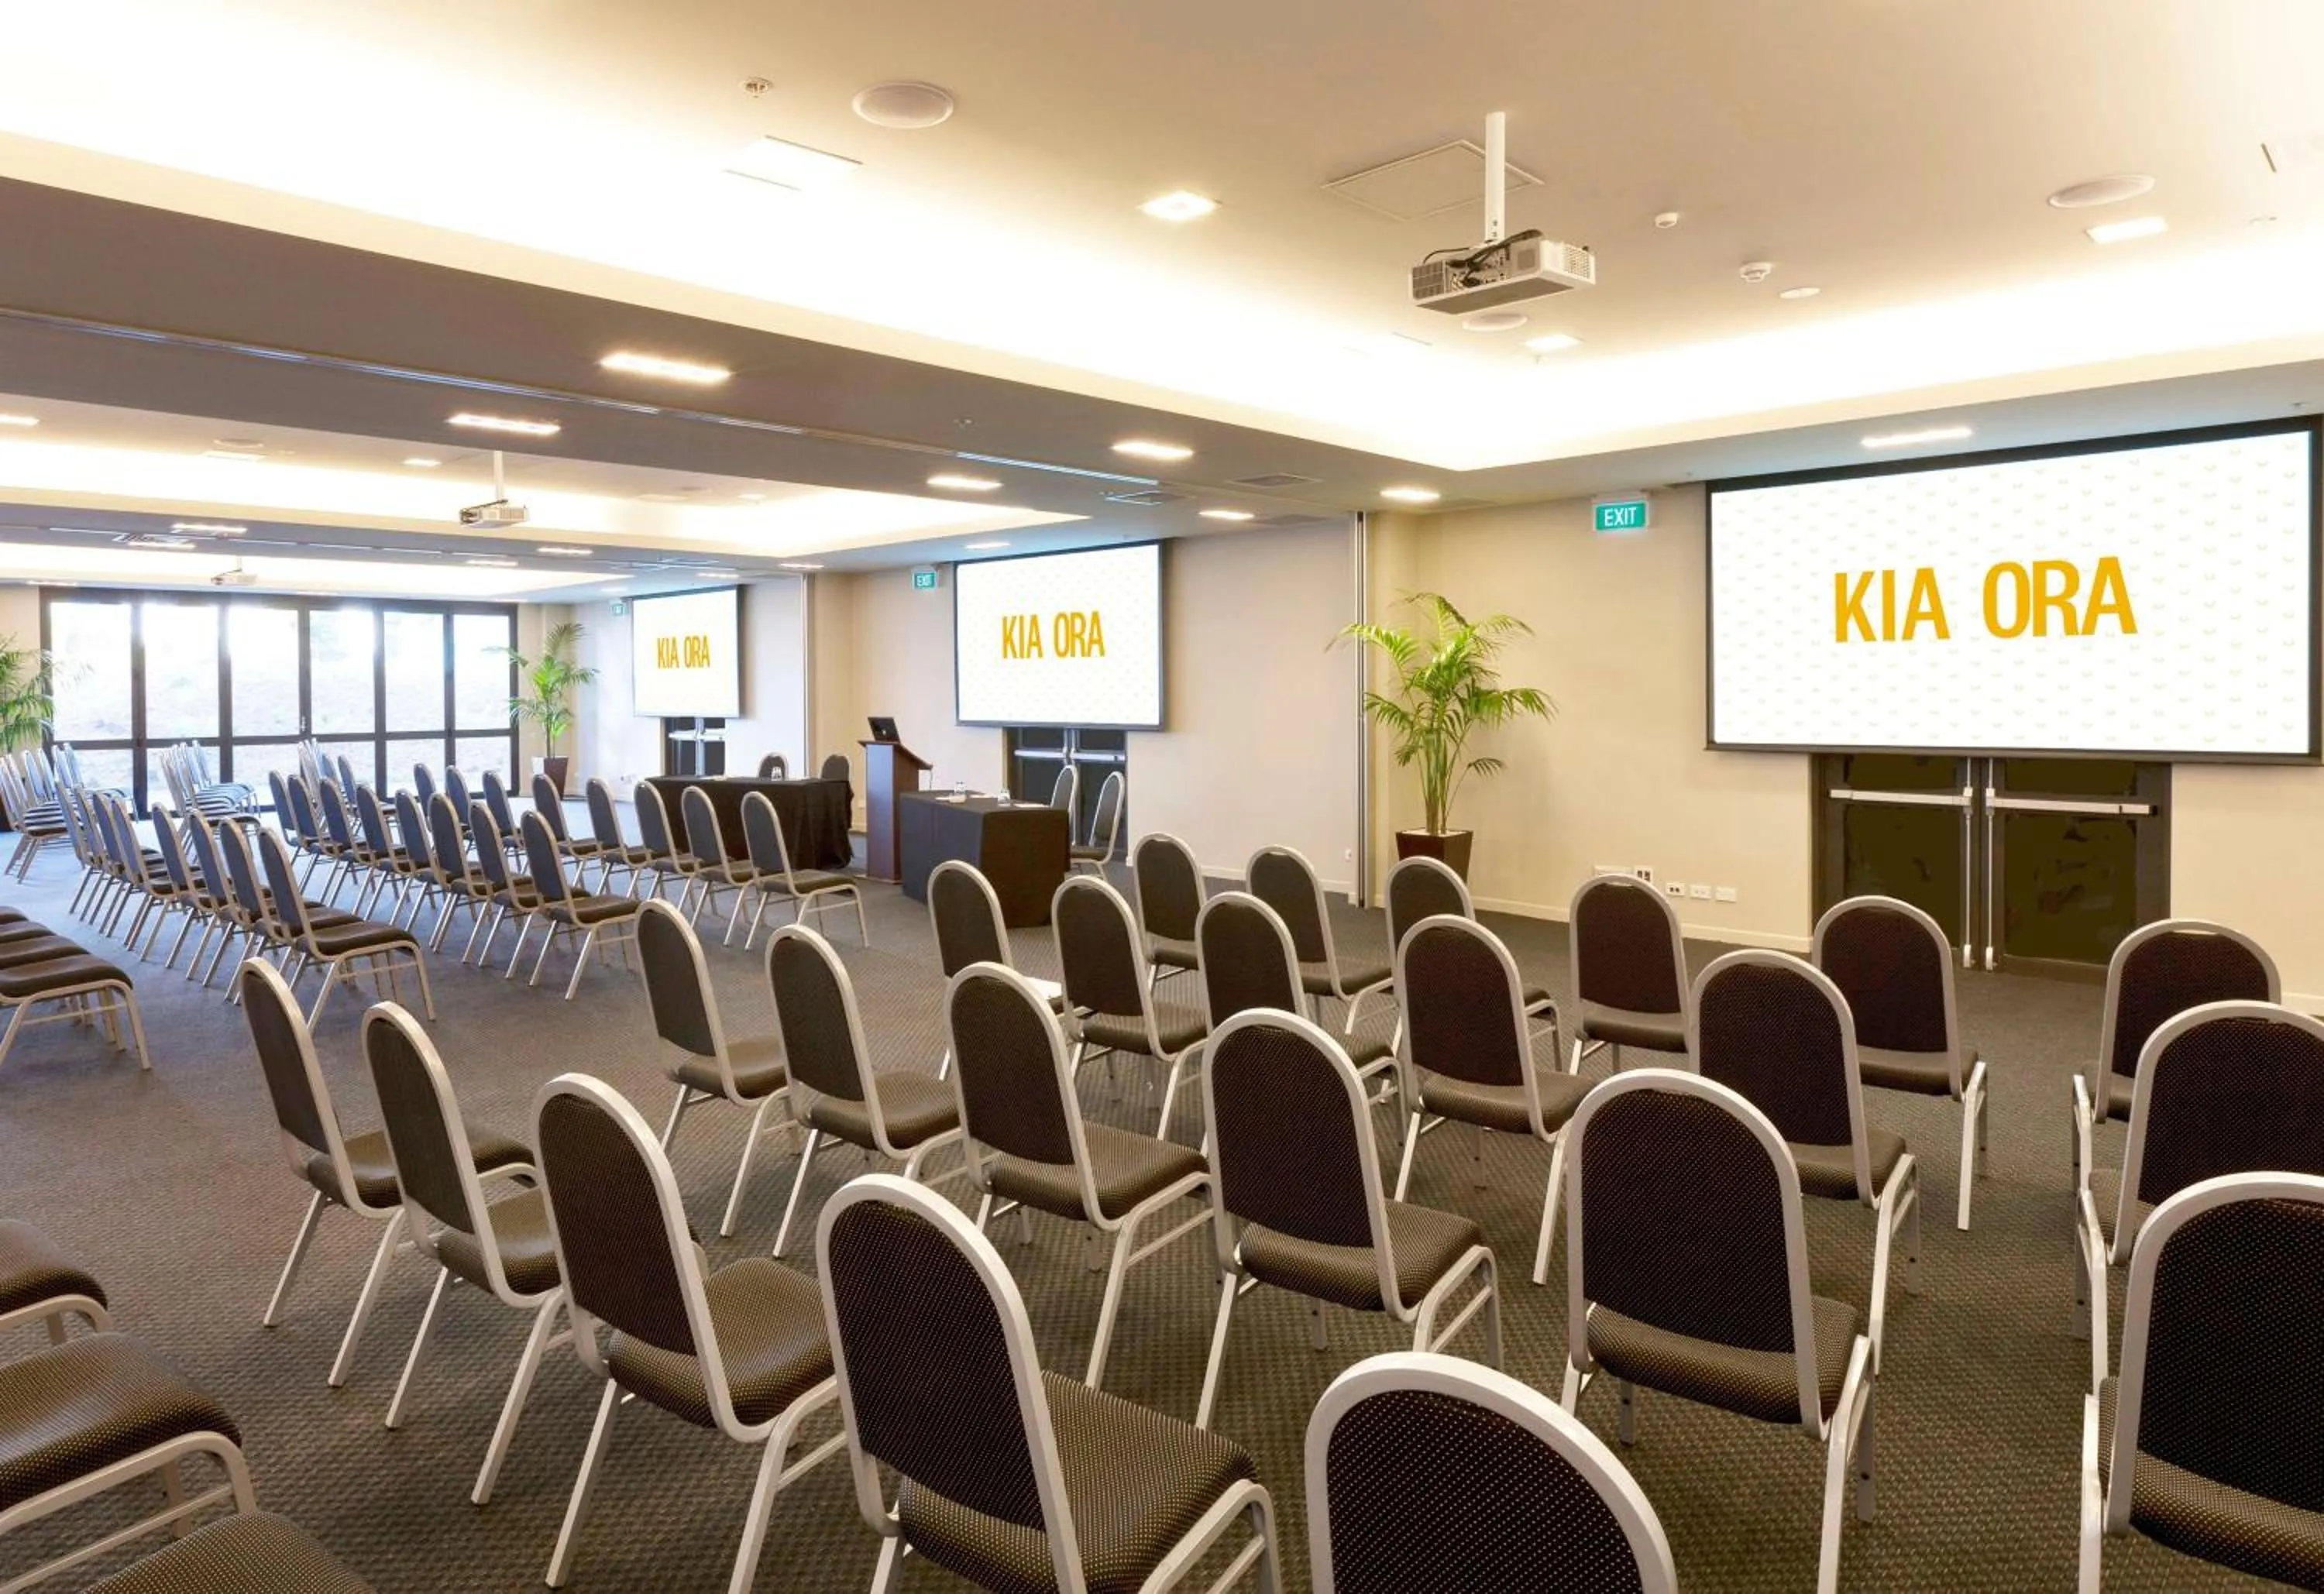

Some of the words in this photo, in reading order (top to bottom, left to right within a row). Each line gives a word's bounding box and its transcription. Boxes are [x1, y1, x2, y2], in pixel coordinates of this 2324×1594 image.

[1604, 507, 1637, 527] EXIT
[1834, 566, 1951, 644] KIA
[1982, 555, 2137, 639] ORA
[657, 636, 679, 668] KIA
[684, 634, 710, 668] ORA
[1002, 613, 1043, 659] KIA
[1053, 609, 1105, 658] ORA
